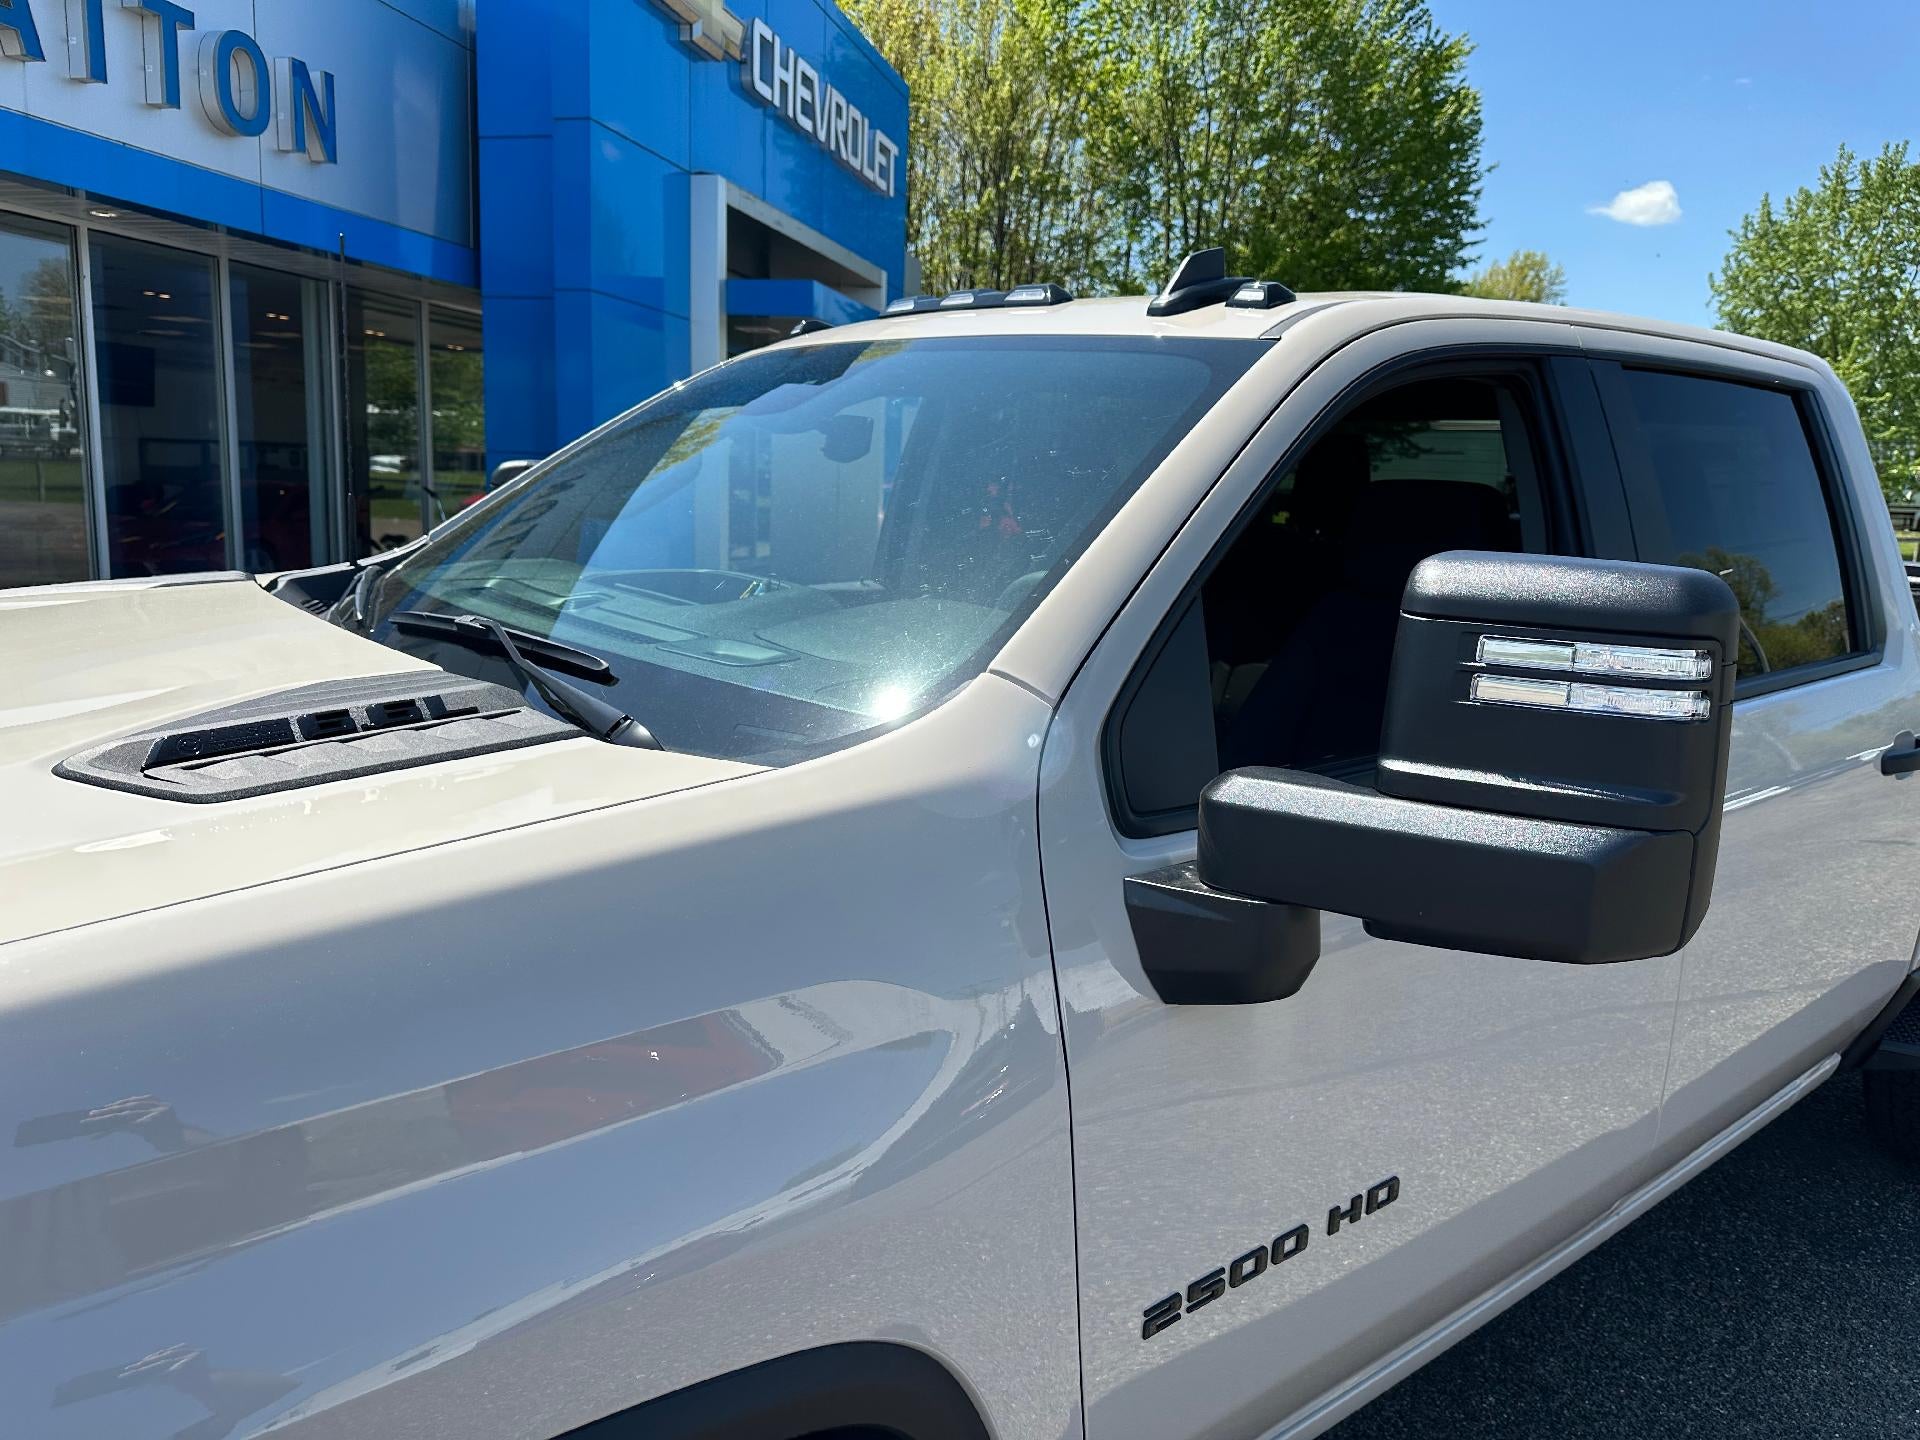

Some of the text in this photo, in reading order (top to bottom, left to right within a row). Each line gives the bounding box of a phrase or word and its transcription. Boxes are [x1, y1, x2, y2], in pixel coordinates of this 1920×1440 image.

[752, 17, 899, 197] CHEVROLET
[1142, 1175, 1400, 1340] 2500 HD
